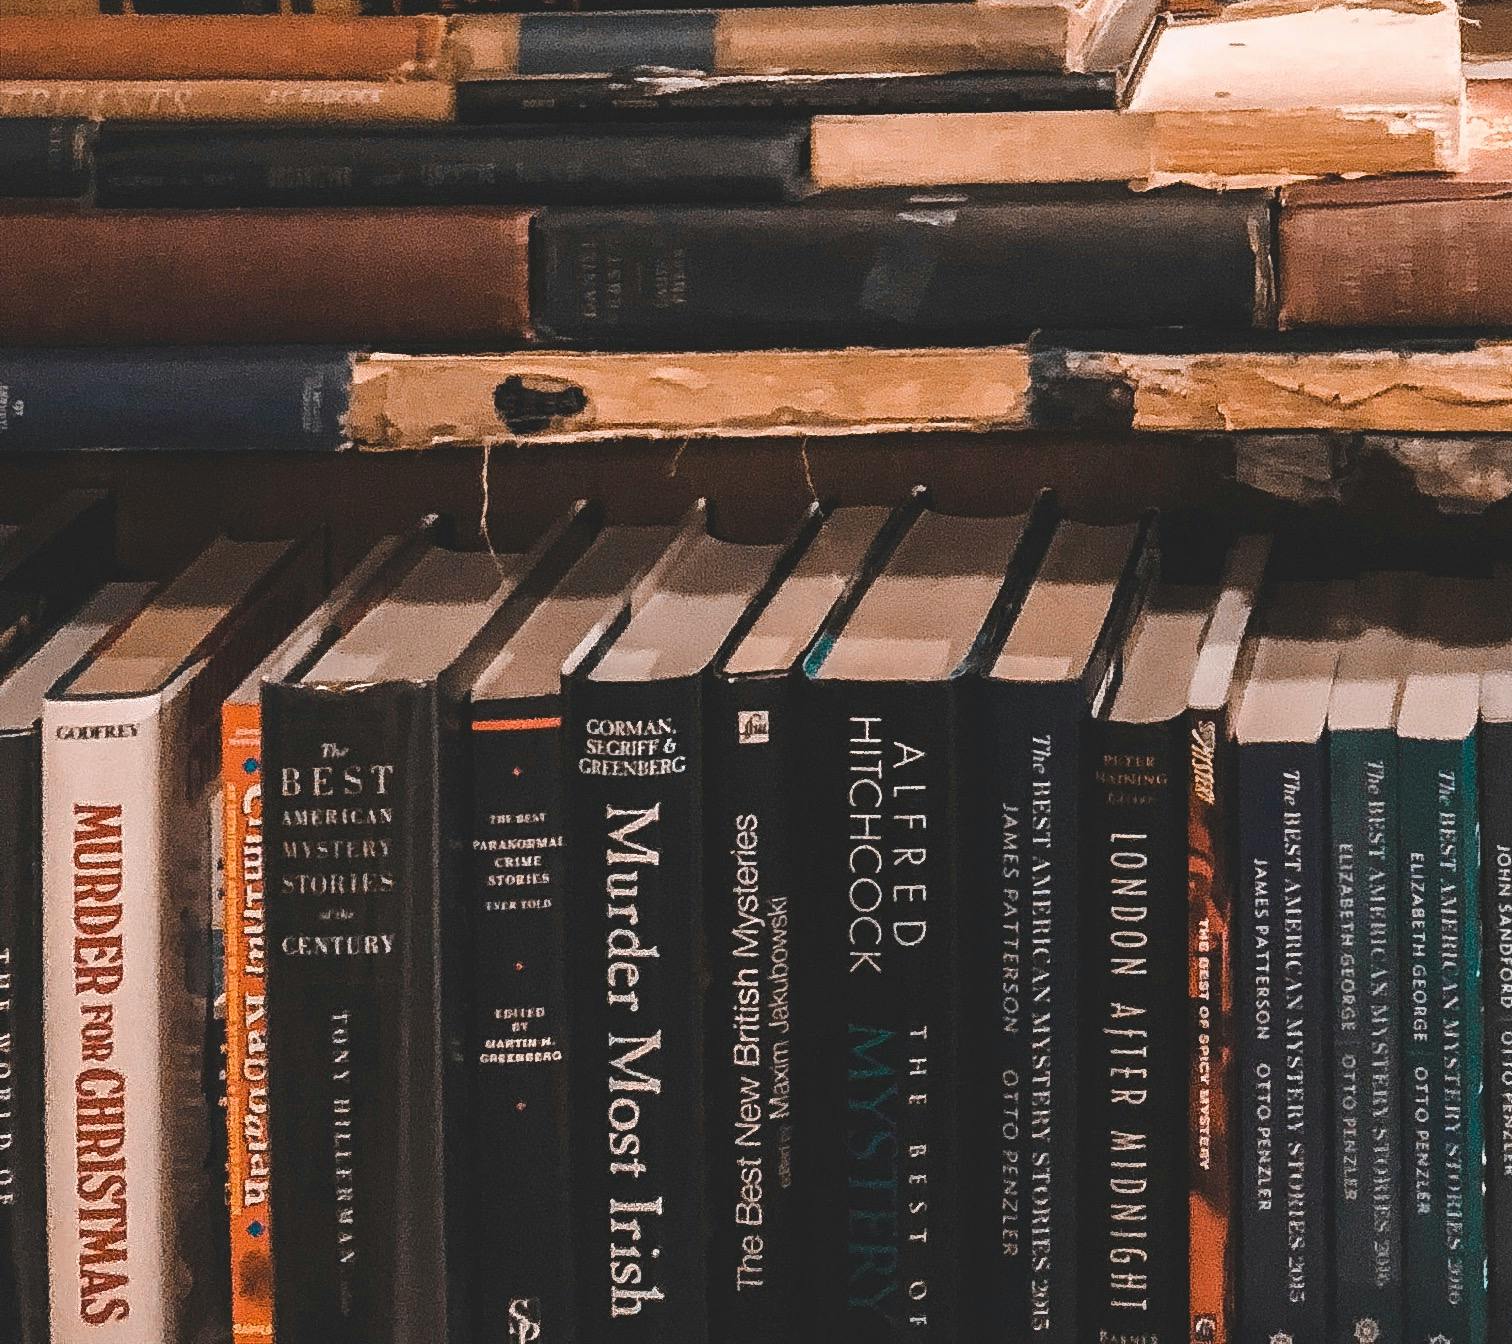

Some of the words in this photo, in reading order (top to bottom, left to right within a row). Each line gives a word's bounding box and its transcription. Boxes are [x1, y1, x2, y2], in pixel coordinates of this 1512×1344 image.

[54, 724, 140, 740] GODFREY
[578, 757, 686, 775] GREENBERG
[281, 764, 394, 796] BEST
[281, 808, 393, 822] AMERICAN
[849, 716, 884, 974] HITCHCOCK
[891, 741, 927, 947] ALFRED
[1001, 802, 1019, 879] JAMES
[1496, 845, 1512, 896] JOHN
[71, 804, 124, 994] MURDER
[604, 802, 662, 1013] Murder
[733, 814, 763, 959] Mysteries
[1108, 831, 1147, 976] LONDON
[1253, 858, 1271, 919] JAMES
[1409, 852, 1426, 957] ELIZABETH
[281, 935, 394, 954] CENTURY
[768, 896, 789, 1028] Jakubowski
[1001, 888, 1020, 1034] PATTERSON
[1253, 925, 1272, 1041] PATTERSON
[80, 1004, 113, 1061] FOR
[331, 1010, 353, 1082] TONY
[732, 969, 763, 1068] British
[1411, 965, 1429, 1042] GEORGE
[768, 1032, 789, 1119] Maxim
[908, 1023, 928, 1106] THE
[1102, 1003, 1147, 1106] AFTER
[1254, 1063, 1272, 1122] OTTO
[1412, 1066, 1430, 1123] OTTO
[607, 1029, 663, 1178] Most
[734, 1077, 763, 1147] New
[1001, 1069, 1020, 1140] OTTO
[75, 1068, 130, 1326] CHRISTMAS
[332, 1099, 355, 1264] HILLERMAN
[734, 1165, 763, 1227] Best
[908, 1143, 928, 1244] BEST
[1001, 1149, 1020, 1257] PENZLER
[1254, 1127, 1272, 1211] PENZLER
[1414, 1129, 1432, 1216] PENZLER
[607, 1195, 665, 1318] Irish
[736, 1235, 764, 1292] The
[1109, 1129, 1148, 1312] MIDNIGHT
[908, 1281, 928, 1327] OF
